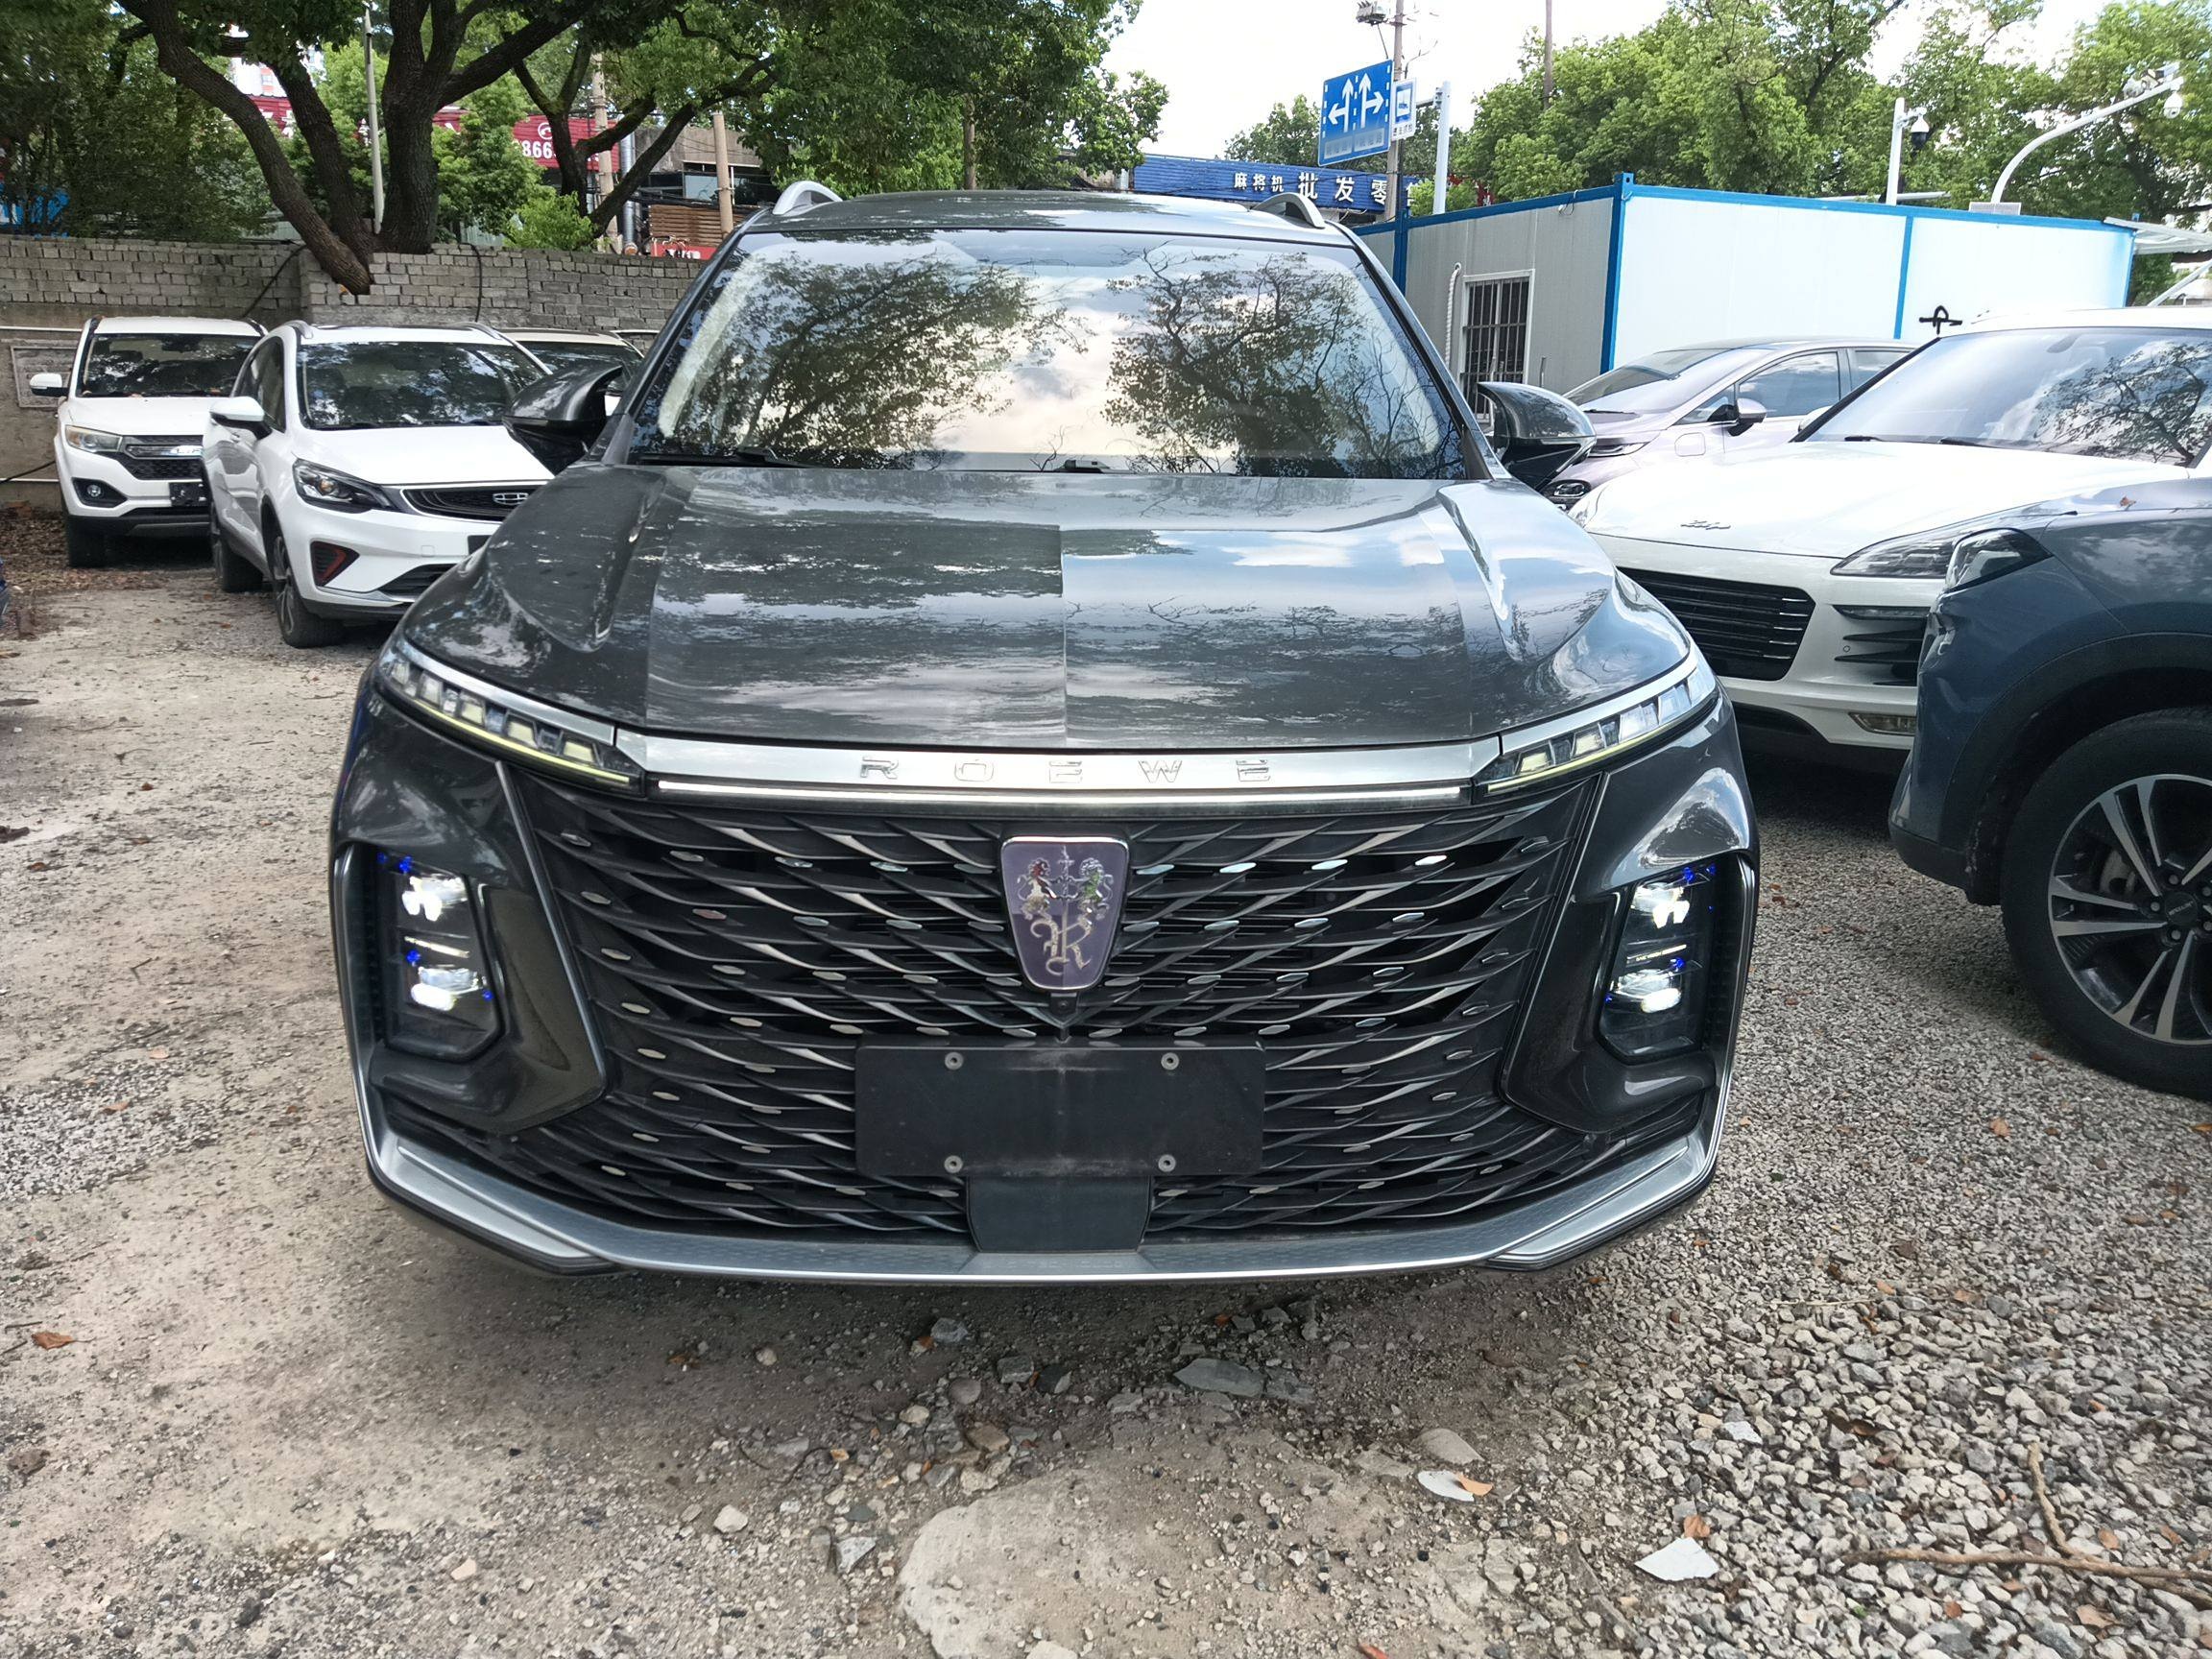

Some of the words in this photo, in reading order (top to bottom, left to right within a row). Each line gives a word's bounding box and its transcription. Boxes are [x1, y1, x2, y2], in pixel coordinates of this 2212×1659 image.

[521, 140, 556, 159] 866
[1234, 172, 1285, 193] 麻将机
[859, 758, 1272, 783] ROEWE
